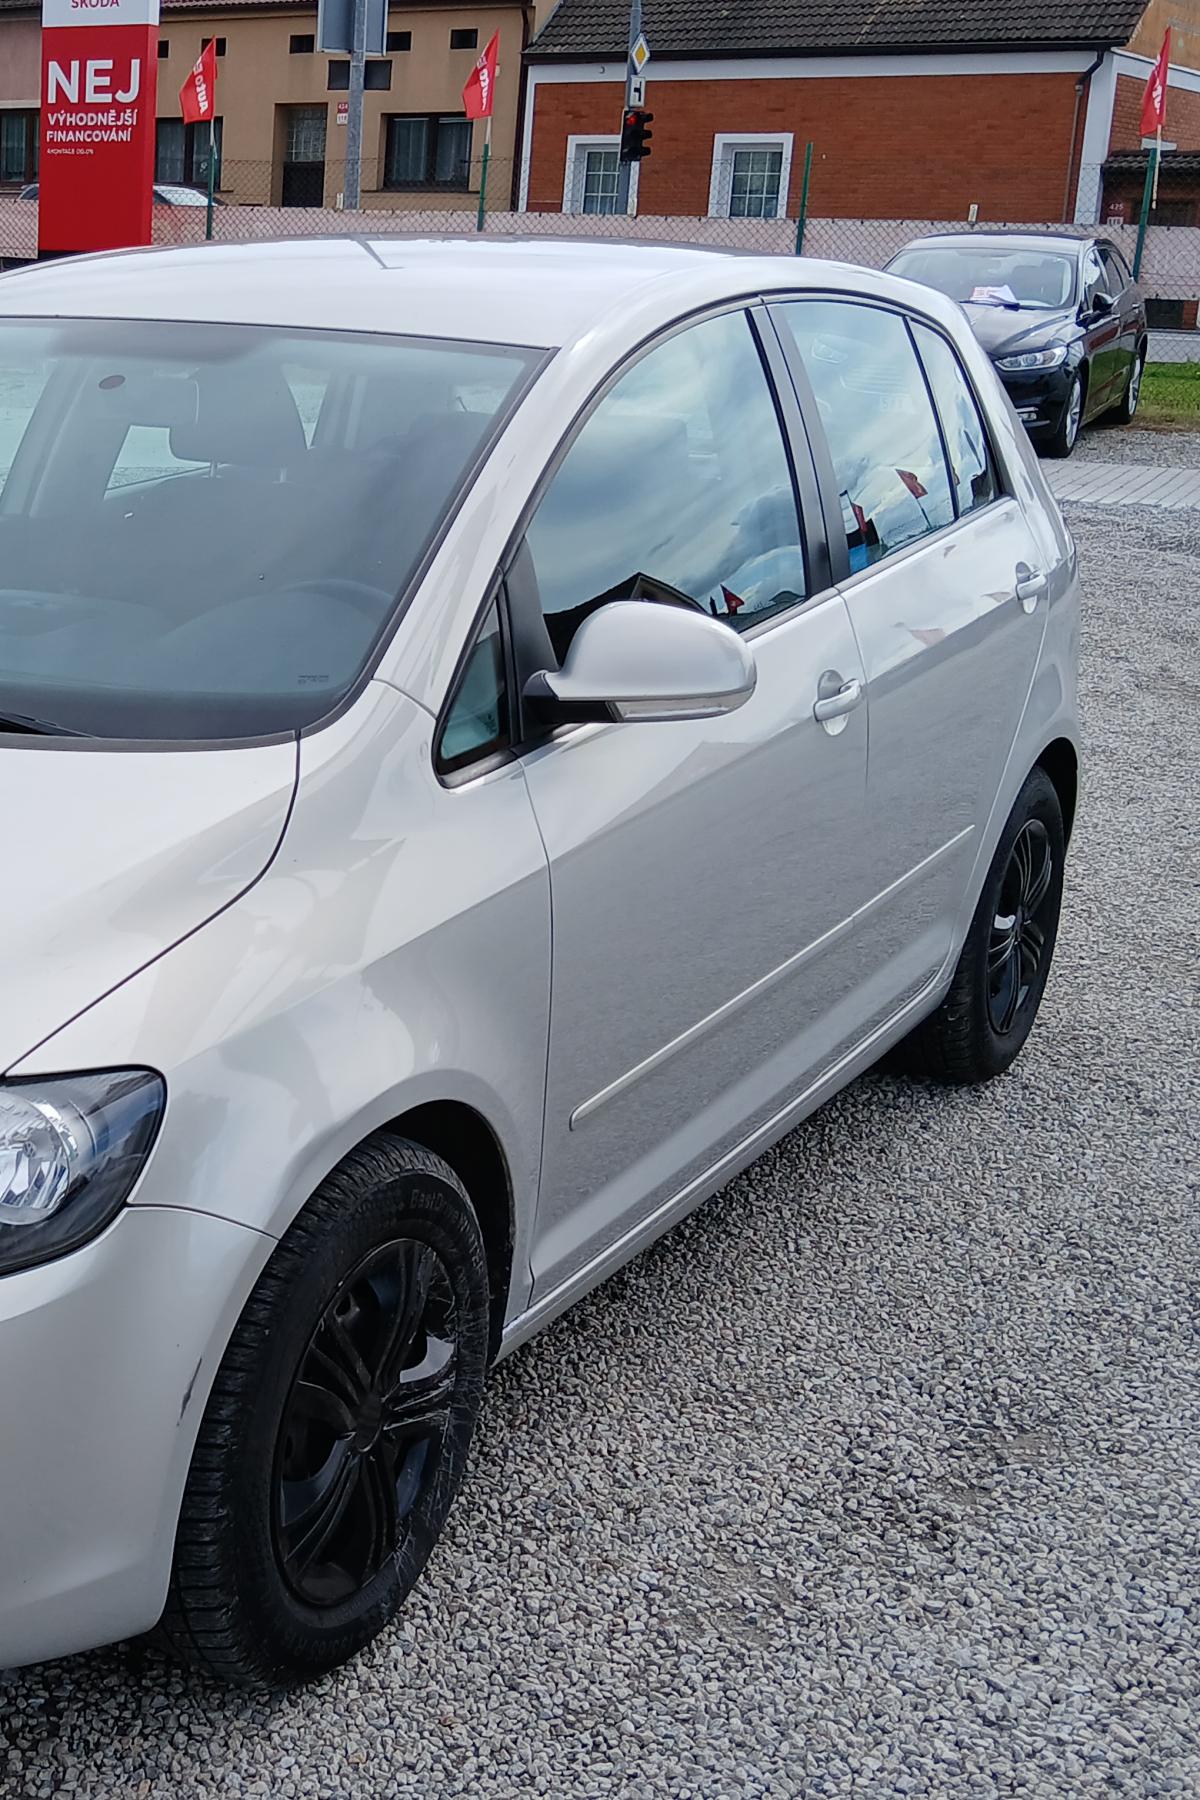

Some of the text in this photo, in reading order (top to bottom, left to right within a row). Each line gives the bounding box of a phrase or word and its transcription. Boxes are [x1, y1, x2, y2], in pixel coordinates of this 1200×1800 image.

[47, 58, 141, 104] NEJ
[47, 109, 138, 126] VÝHODNĚJŠÍ
[46, 128, 132, 143] FINANCOVÁNÍ
